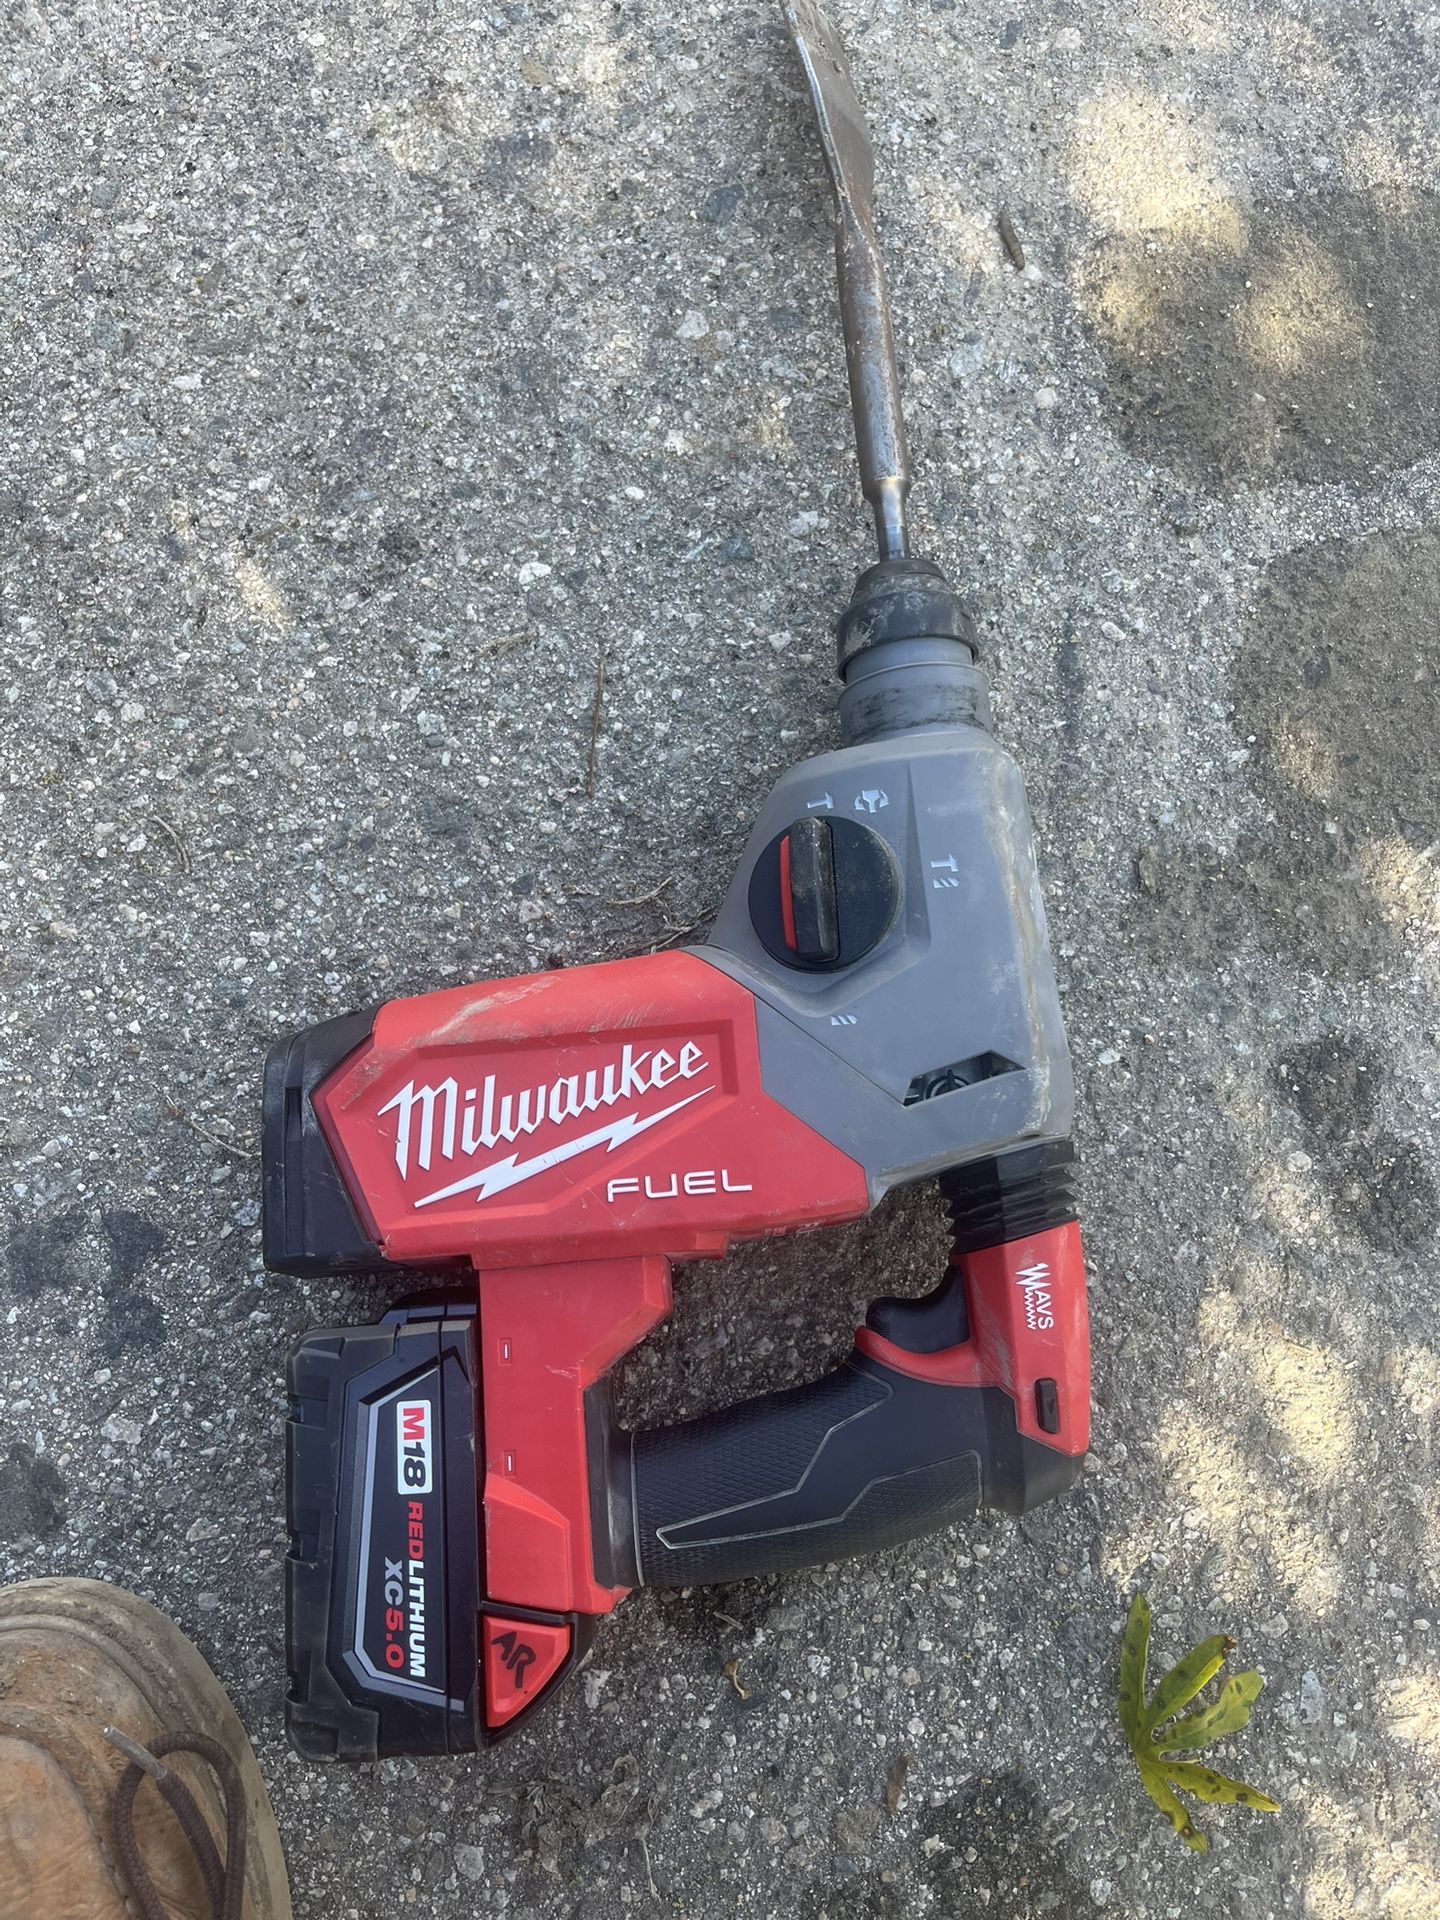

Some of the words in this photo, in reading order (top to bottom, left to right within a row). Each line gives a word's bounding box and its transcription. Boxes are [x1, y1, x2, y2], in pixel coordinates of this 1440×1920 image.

[377, 1041, 709, 1181] Milwaukee
[607, 1169, 753, 1202] FUEL
[402, 1407, 427, 1488] M18
[407, 1501, 426, 1678] REDLITHIUM
